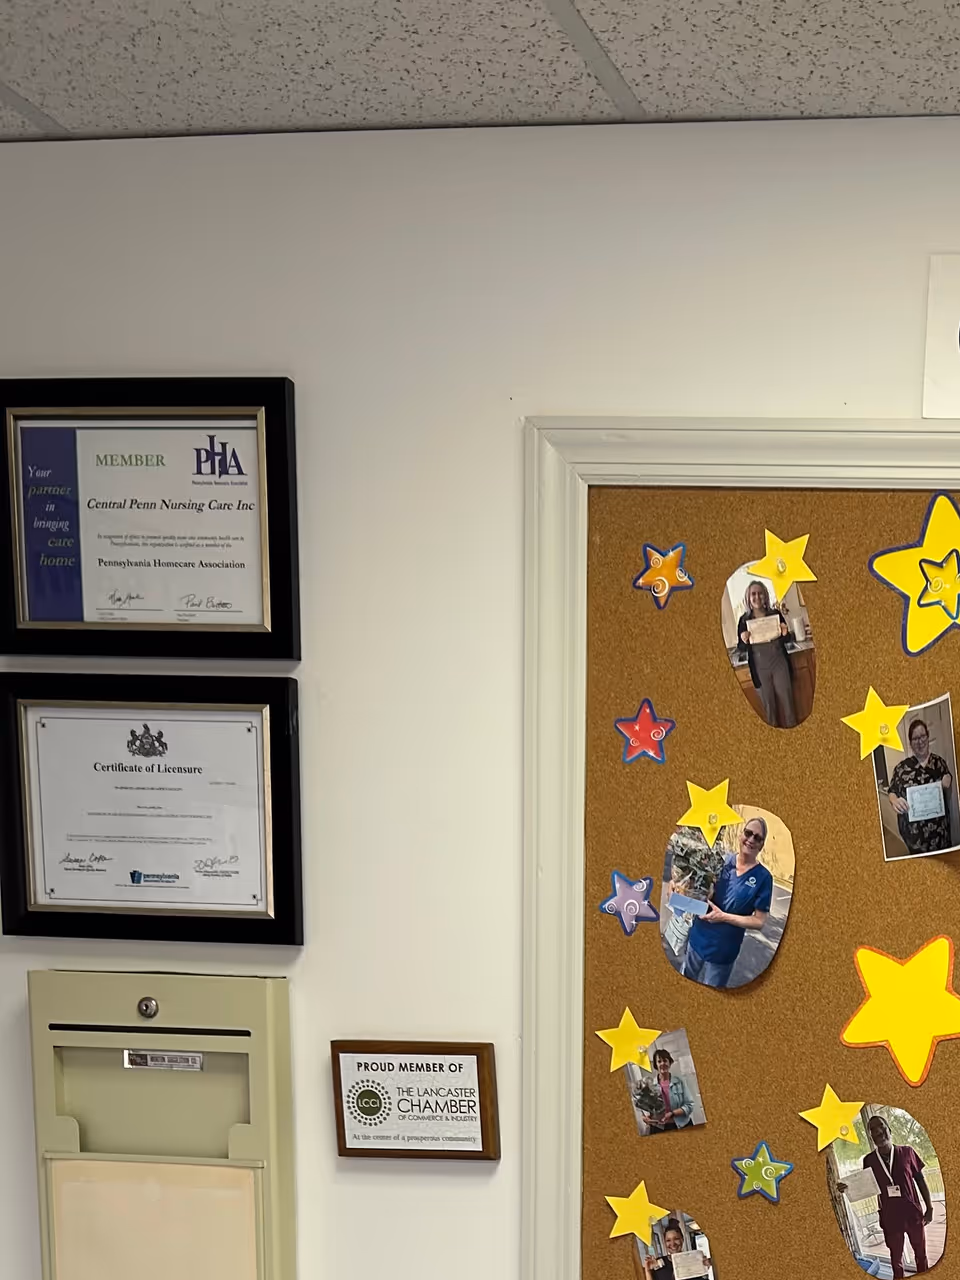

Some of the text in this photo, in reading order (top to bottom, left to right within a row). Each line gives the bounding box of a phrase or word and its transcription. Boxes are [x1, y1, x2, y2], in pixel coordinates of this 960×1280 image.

[95, 453, 166, 467] MEMBER
[28, 465, 52, 478] Your
[27, 485, 72, 499] partner
[45, 501, 56, 512] in
[86, 498, 256, 513] Central Penn Nursing Care Inc
[33, 516, 70, 532] bringing
[47, 537, 75, 547] care
[39, 552, 75, 567] home
[97, 558, 246, 570] Pennsylvania Homecare Association
[93, 762, 203, 775] Certificate of Licensure
[356, 1062, 464, 1073] PROUD MEMBER OF
[396, 1086, 476, 1098] THE LANCASTER
[396, 1098, 477, 1114] CHAMBER
[406, 1135, 441, 1143] prosperous
[441, 1135, 476, 1143] community
